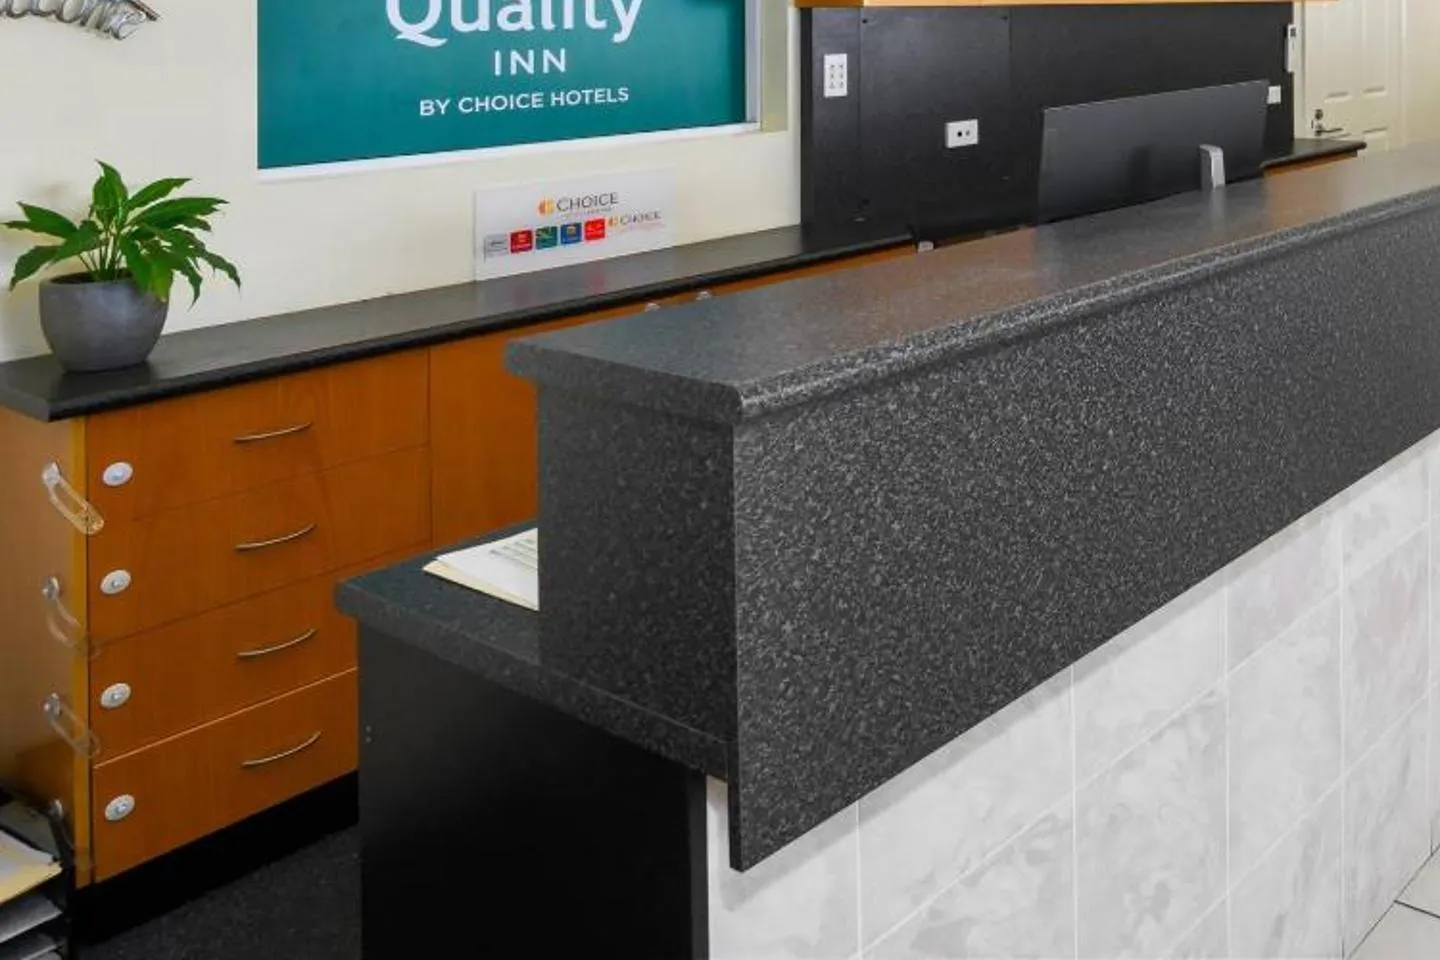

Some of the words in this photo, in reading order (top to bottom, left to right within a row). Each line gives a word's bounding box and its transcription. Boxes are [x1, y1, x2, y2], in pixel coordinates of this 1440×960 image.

[494, 48, 567, 76] INN
[420, 98, 450, 116] BY
[458, 92, 545, 113] CHOICE
[550, 87, 630, 107] HOTELS
[556, 191, 619, 212] CHOICE
